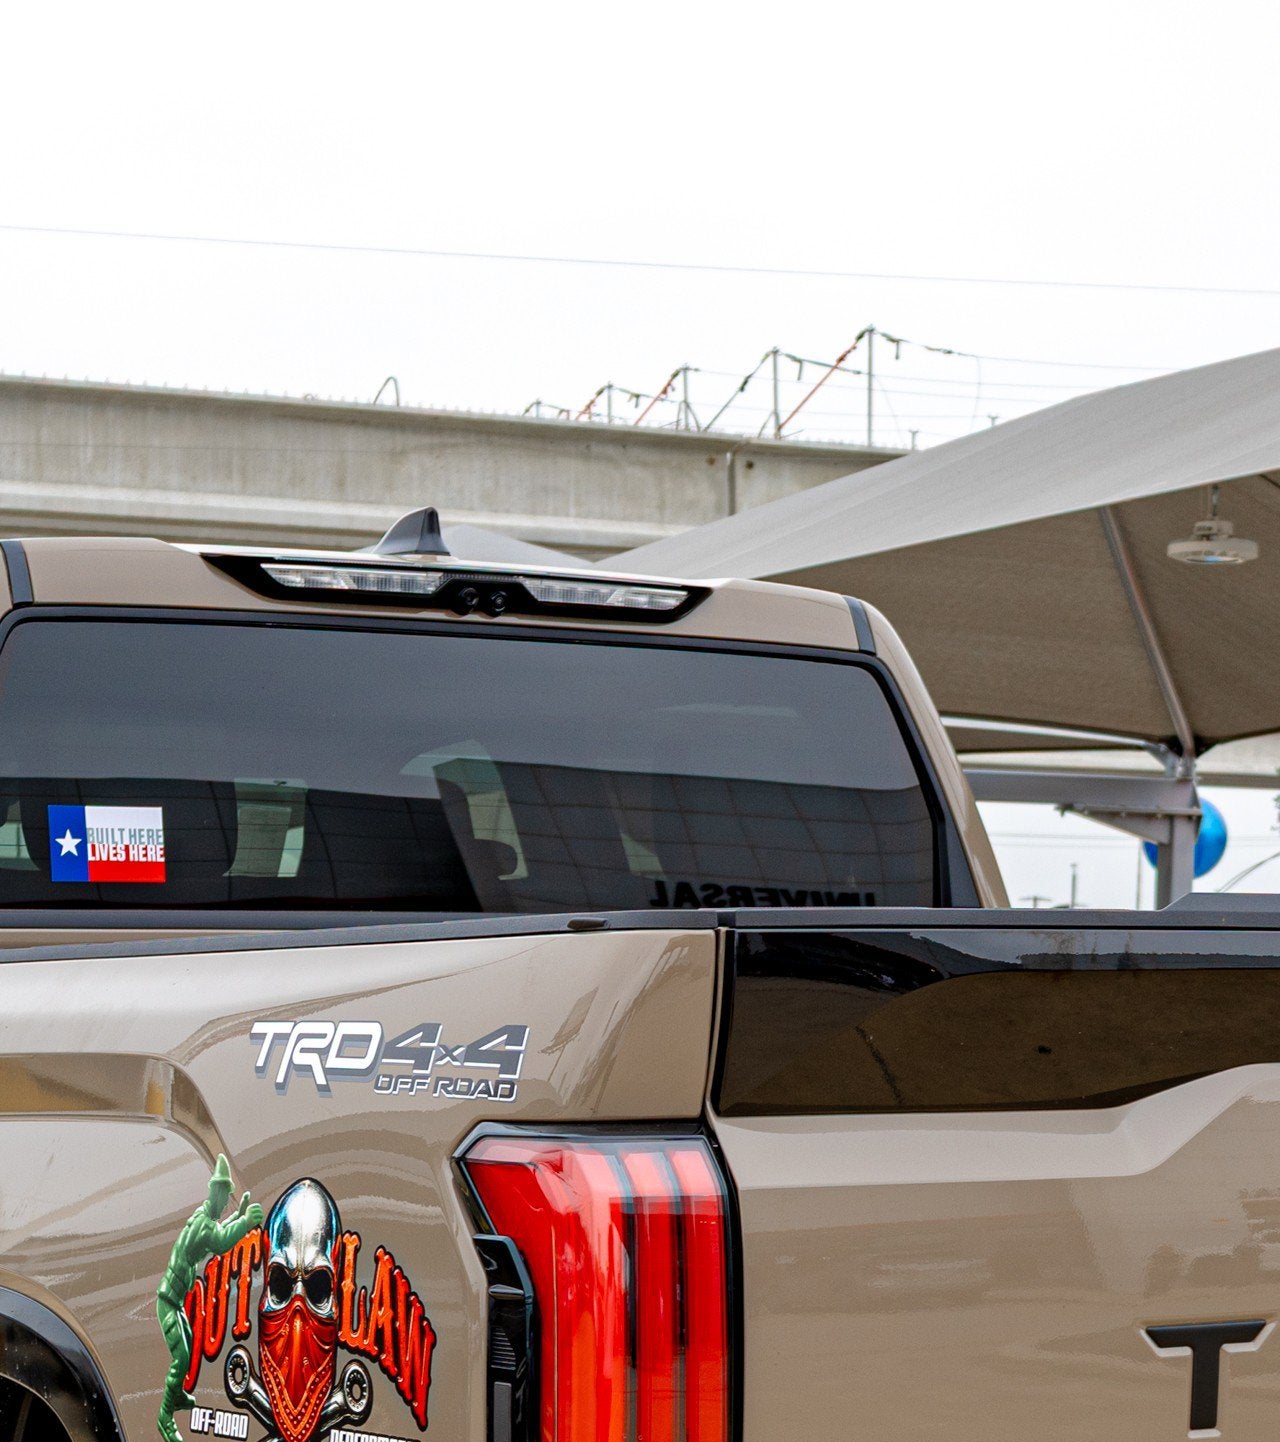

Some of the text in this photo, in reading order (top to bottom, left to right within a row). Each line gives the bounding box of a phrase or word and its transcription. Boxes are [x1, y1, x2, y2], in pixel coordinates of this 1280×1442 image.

[87, 827, 164, 845] BUILT HERE
[88, 843, 166, 862] LIVES HERE
[249, 1021, 384, 1097] TRD
[373, 1074, 518, 1103] OFF ROAD
[190, 1407, 250, 1439] OFF-ROAD
